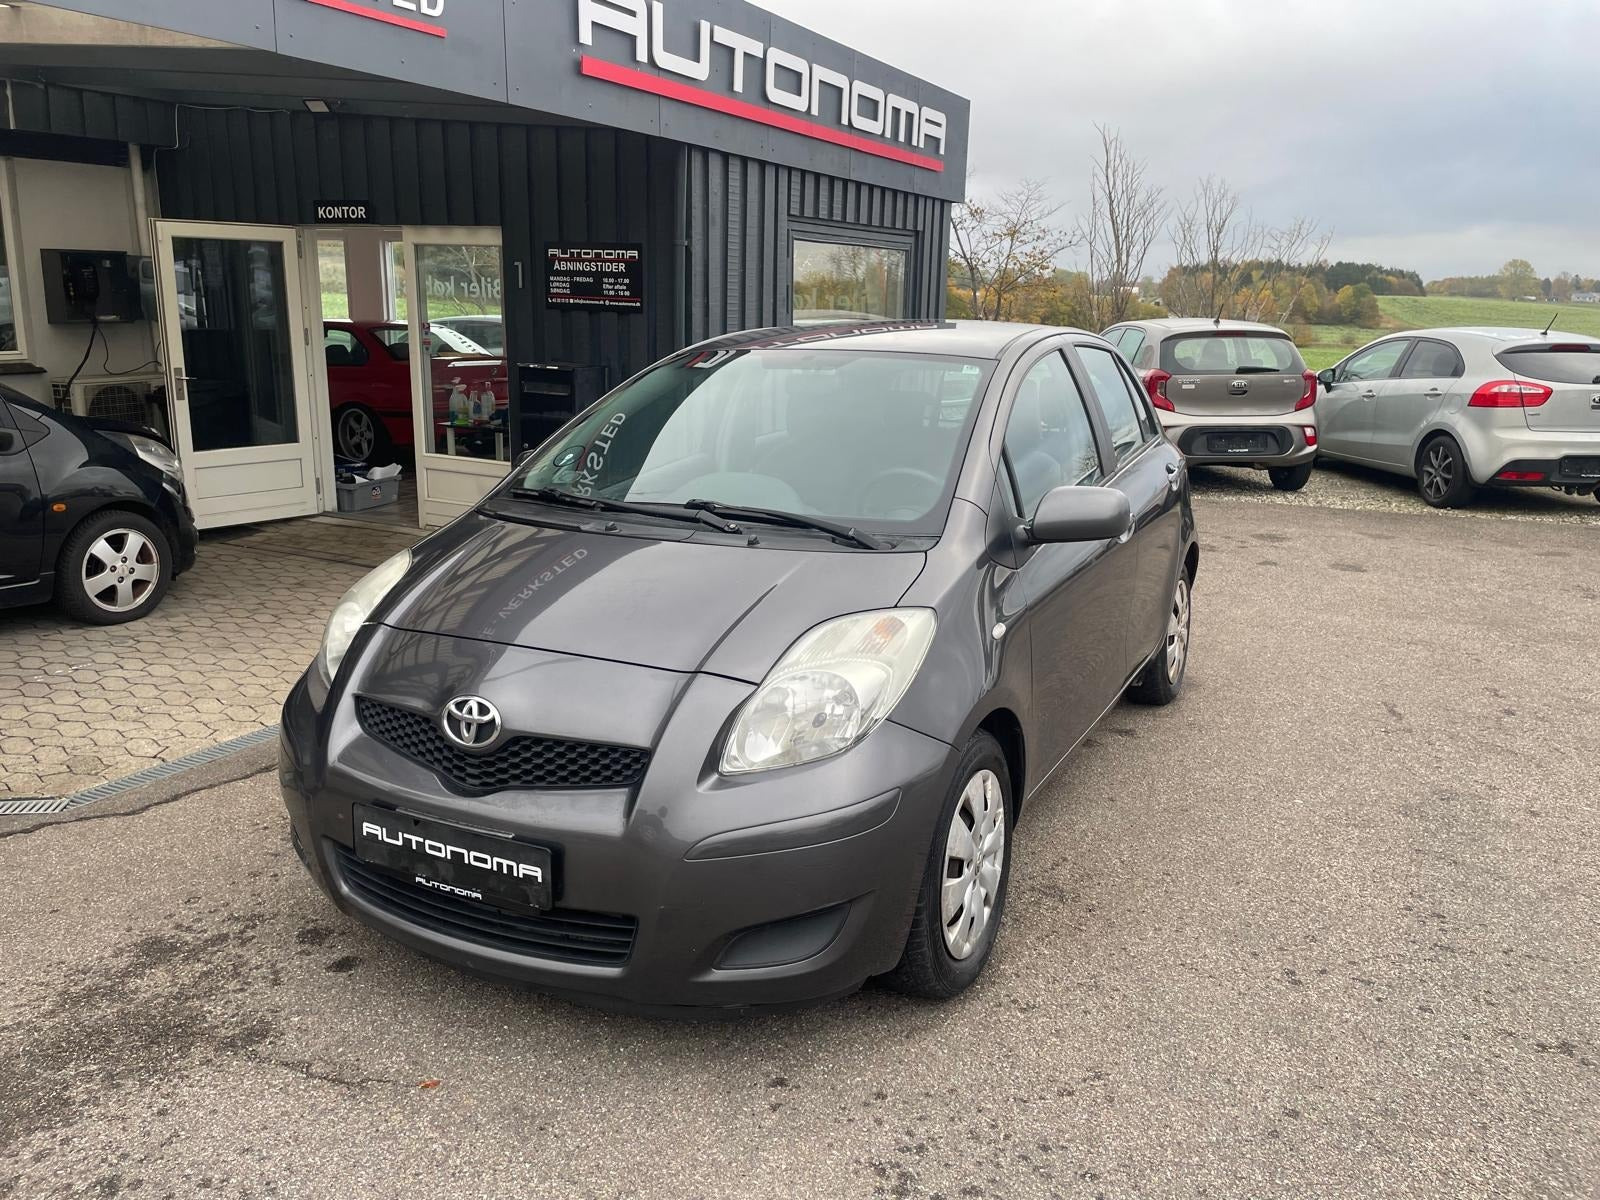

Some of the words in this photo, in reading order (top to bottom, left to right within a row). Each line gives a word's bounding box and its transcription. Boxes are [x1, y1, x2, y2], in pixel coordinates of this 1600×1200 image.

[578, 0, 947, 156] AUTONOMA
[318, 206, 366, 219] KONTOR
[548, 248, 639, 260] AUTONOMA
[553, 260, 626, 272] ÅBNINGSTIDER
[361, 821, 543, 883] AUTONOMA
[415, 875, 483, 902] AUTONOMA
